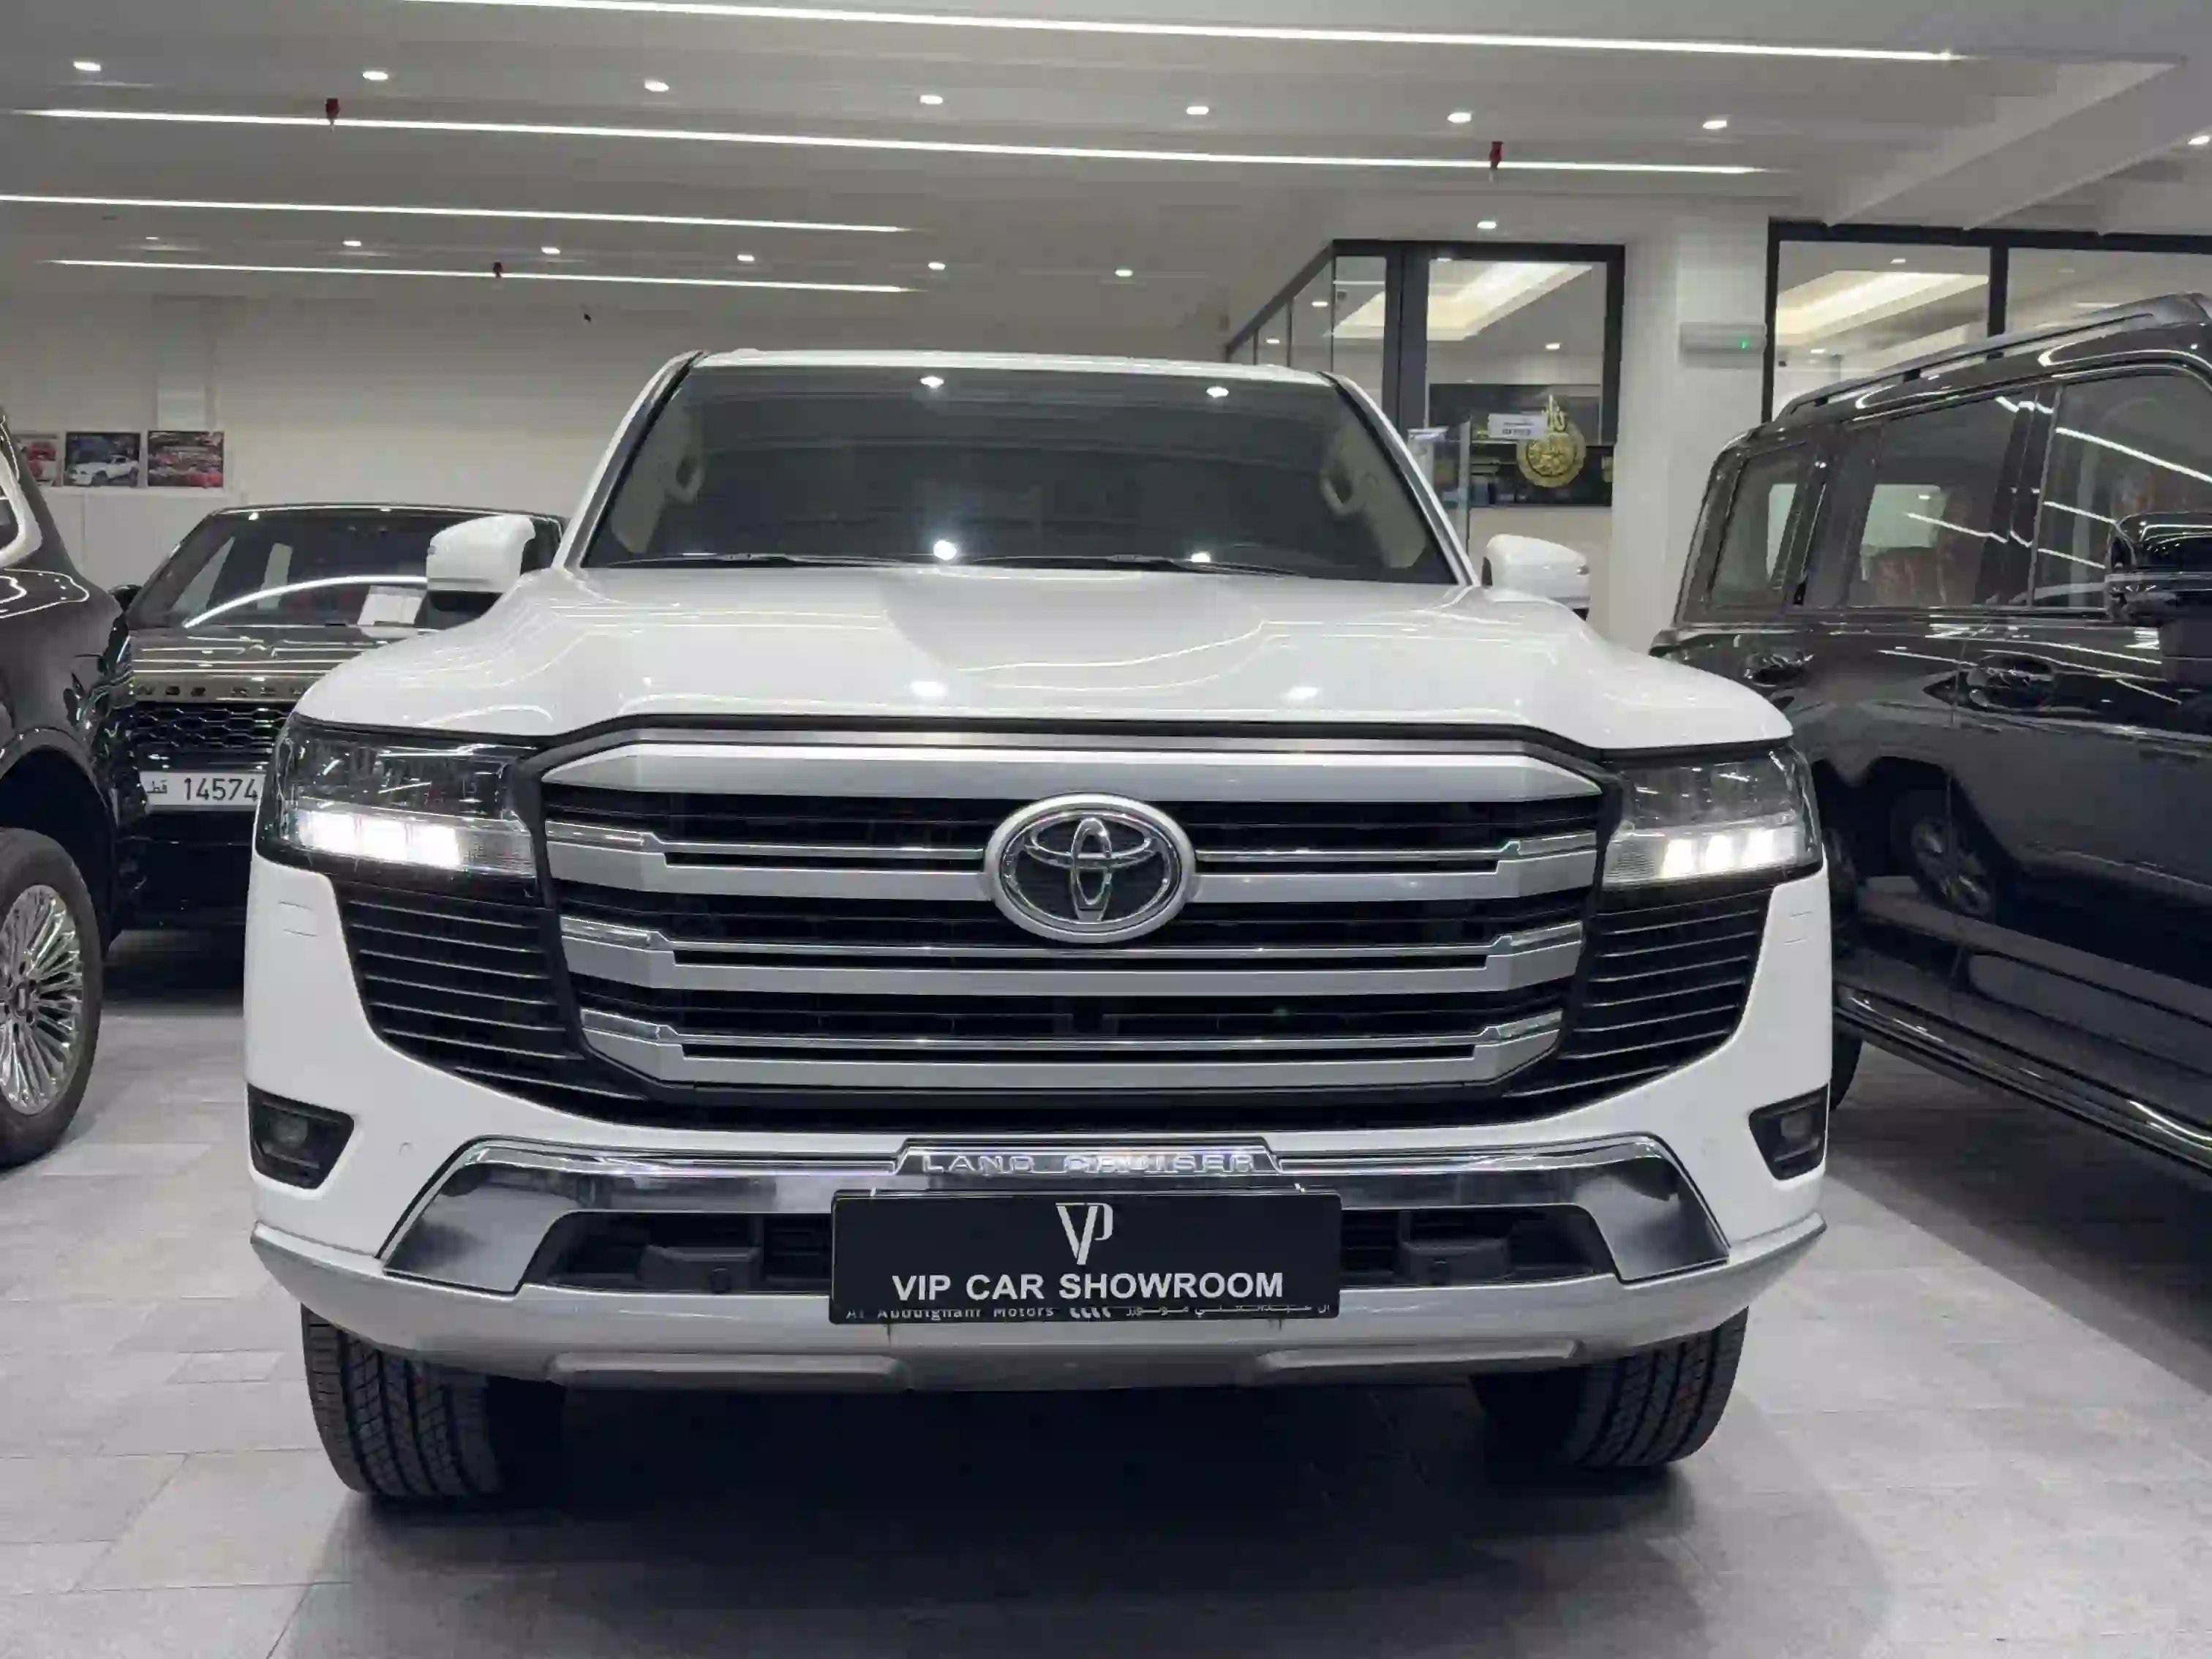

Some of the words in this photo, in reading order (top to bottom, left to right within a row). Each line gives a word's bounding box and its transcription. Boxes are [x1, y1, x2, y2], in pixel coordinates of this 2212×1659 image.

[184, 777, 258, 801] 14574
[922, 1154, 1035, 1174] LAND
[1063, 1154, 1255, 1173] CRUISER
[892, 1274, 951, 1301] VIP
[966, 1274, 1045, 1301] CAR
[1058, 1272, 1283, 1299] SHOWROOM
[993, 1307, 1054, 1317] Motors
